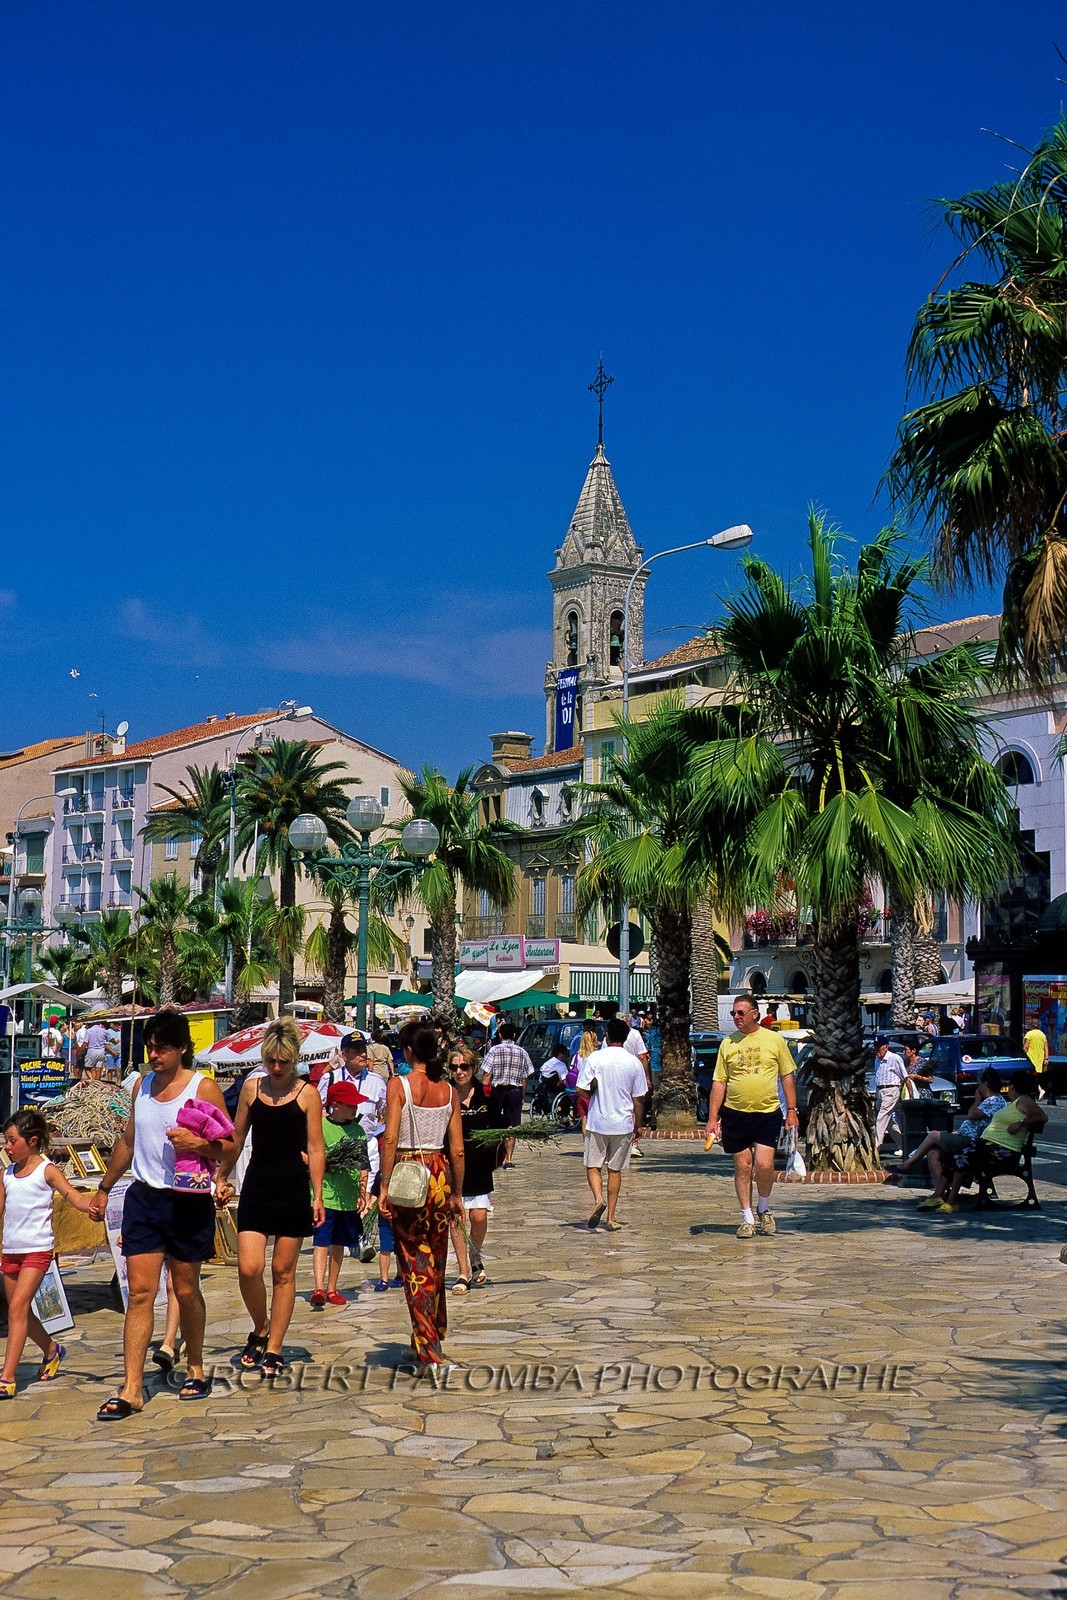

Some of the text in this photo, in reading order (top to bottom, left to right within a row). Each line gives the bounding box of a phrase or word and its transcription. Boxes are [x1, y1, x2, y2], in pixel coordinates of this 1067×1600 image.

[489, 941, 499, 951] Le
[525, 944, 555, 957] Restaurant
[20, 1060, 42, 1072] PECHE
[46, 1060, 65, 1072] GROS
